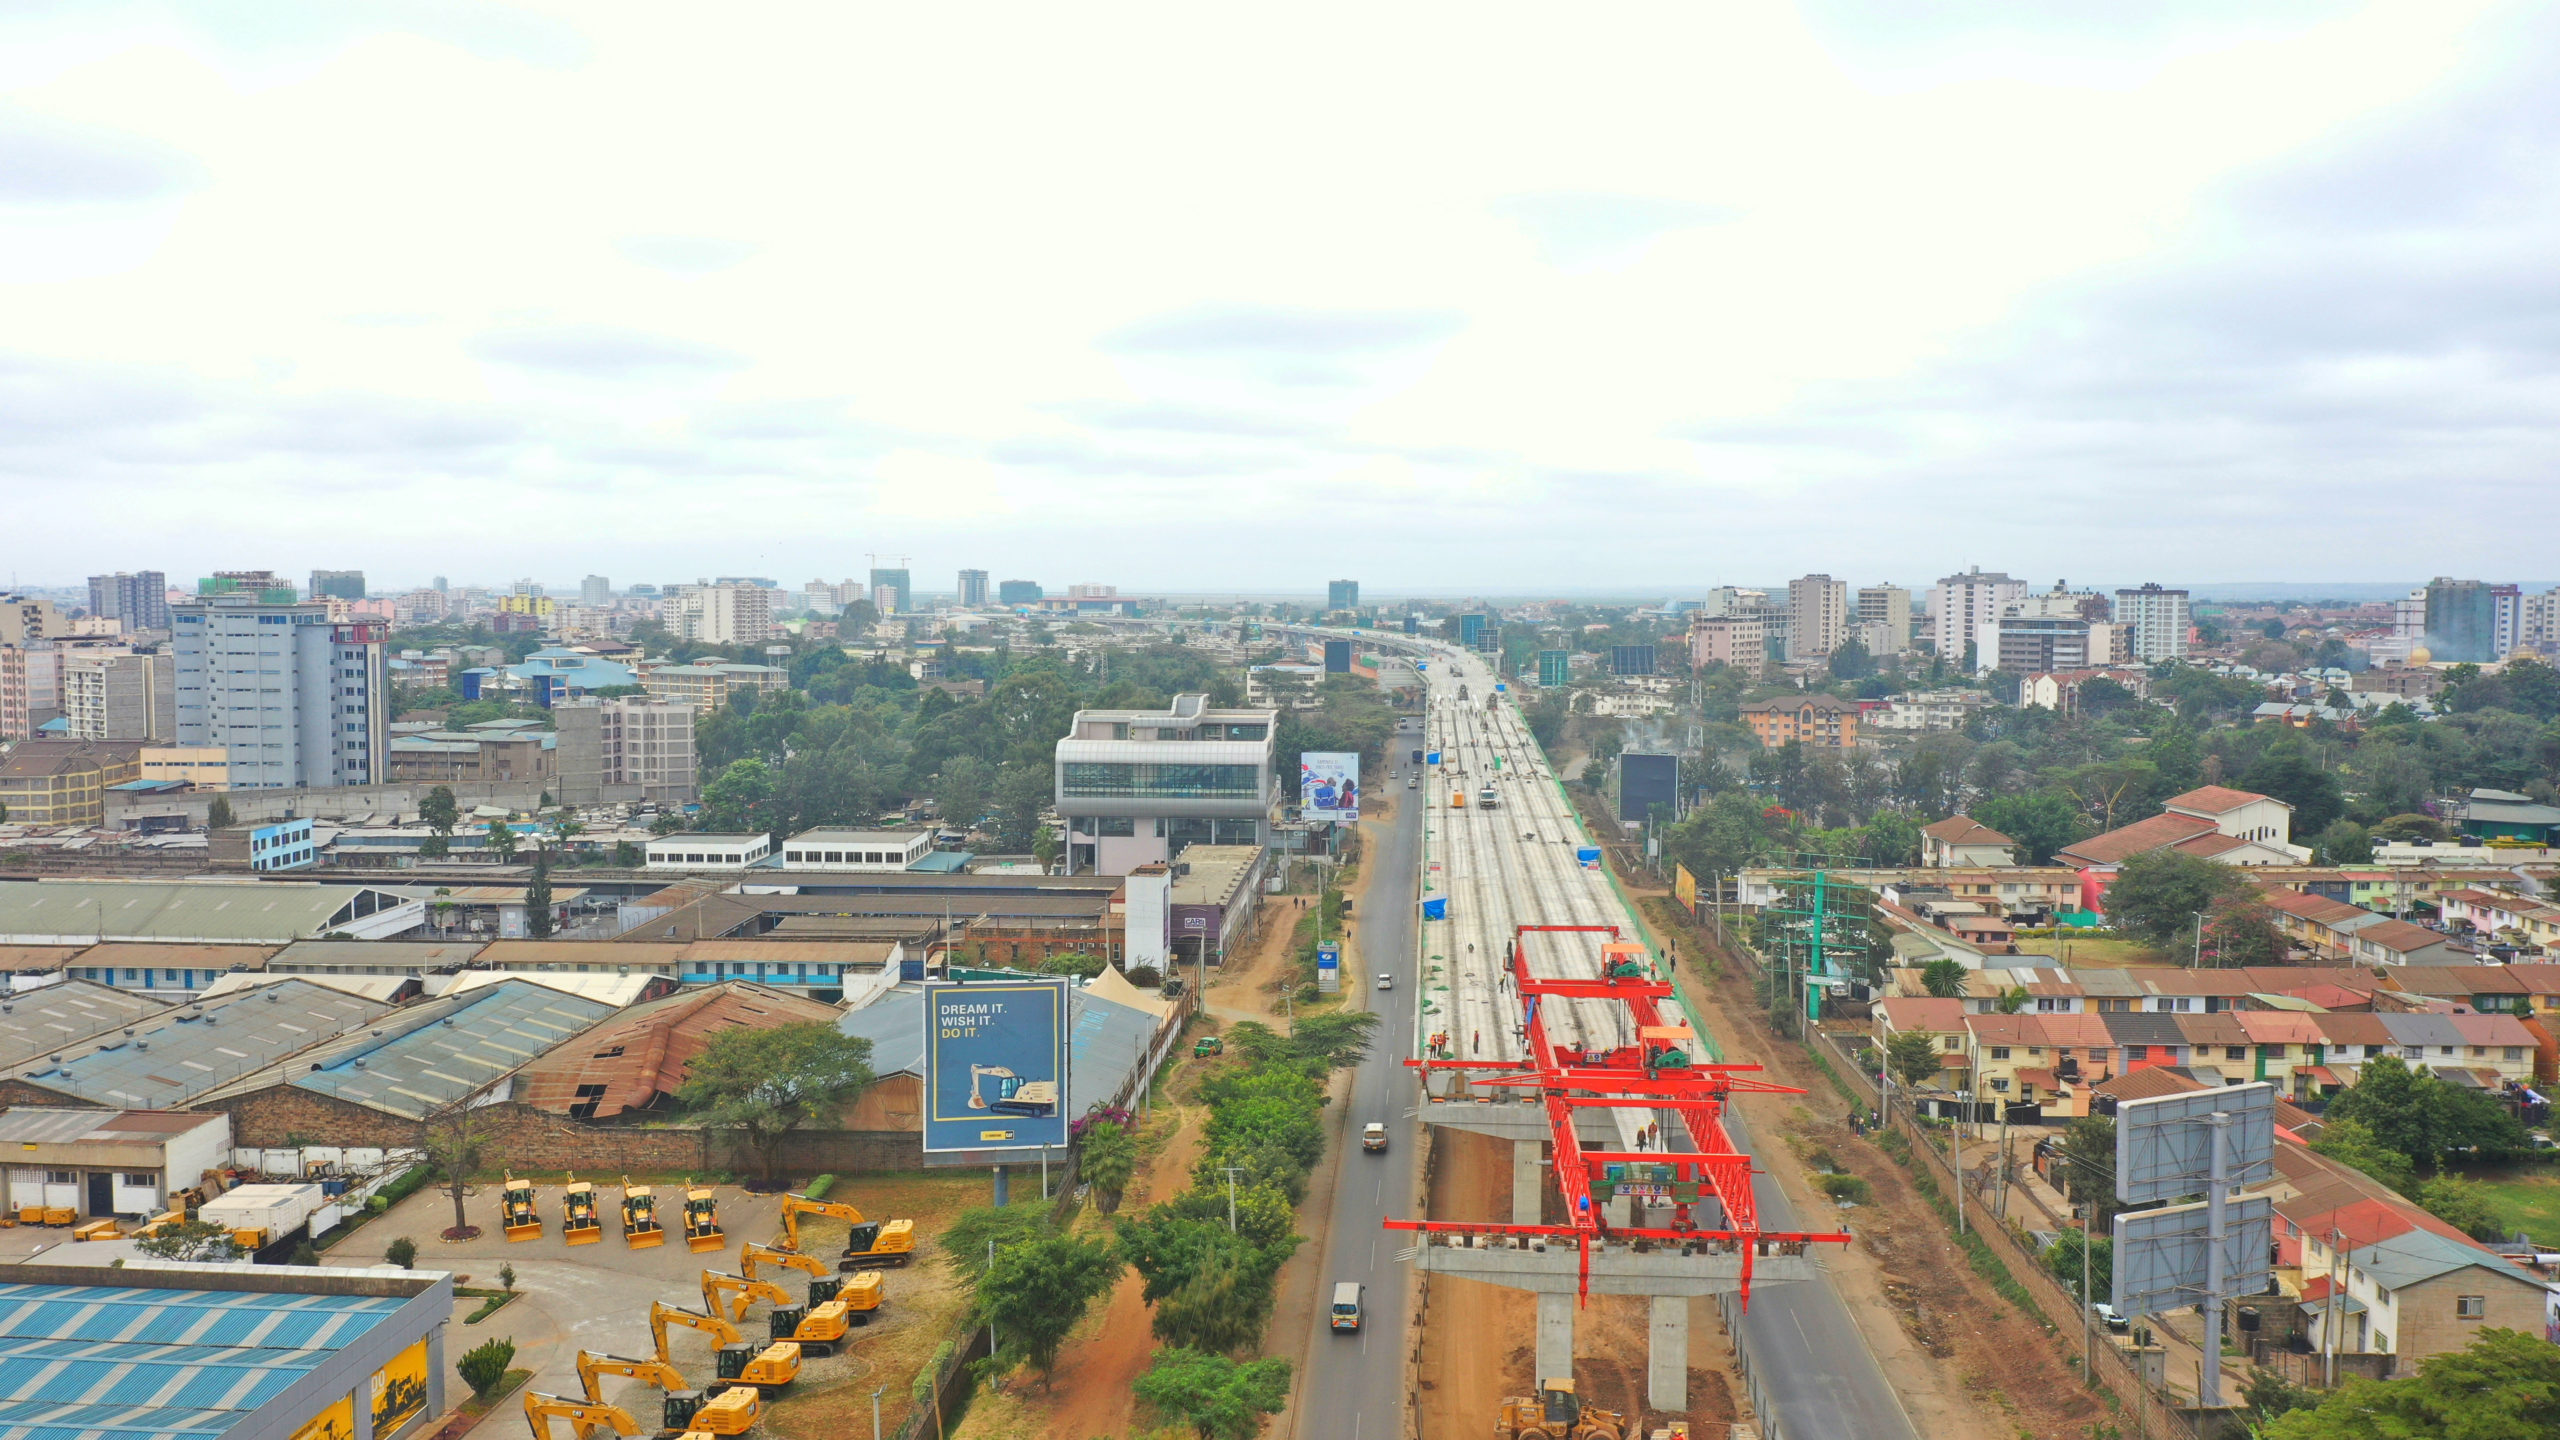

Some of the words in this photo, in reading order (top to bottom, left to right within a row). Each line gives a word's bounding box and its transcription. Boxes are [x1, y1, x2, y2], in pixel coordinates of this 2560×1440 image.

[941, 1004, 988, 1014] DREAM
[992, 1003, 1008, 1014] IT.
[941, 1016, 975, 1026] WISH
[980, 1016, 996, 1026] IT.
[942, 1028, 960, 1038] DO
[964, 1028, 980, 1038] IT.
